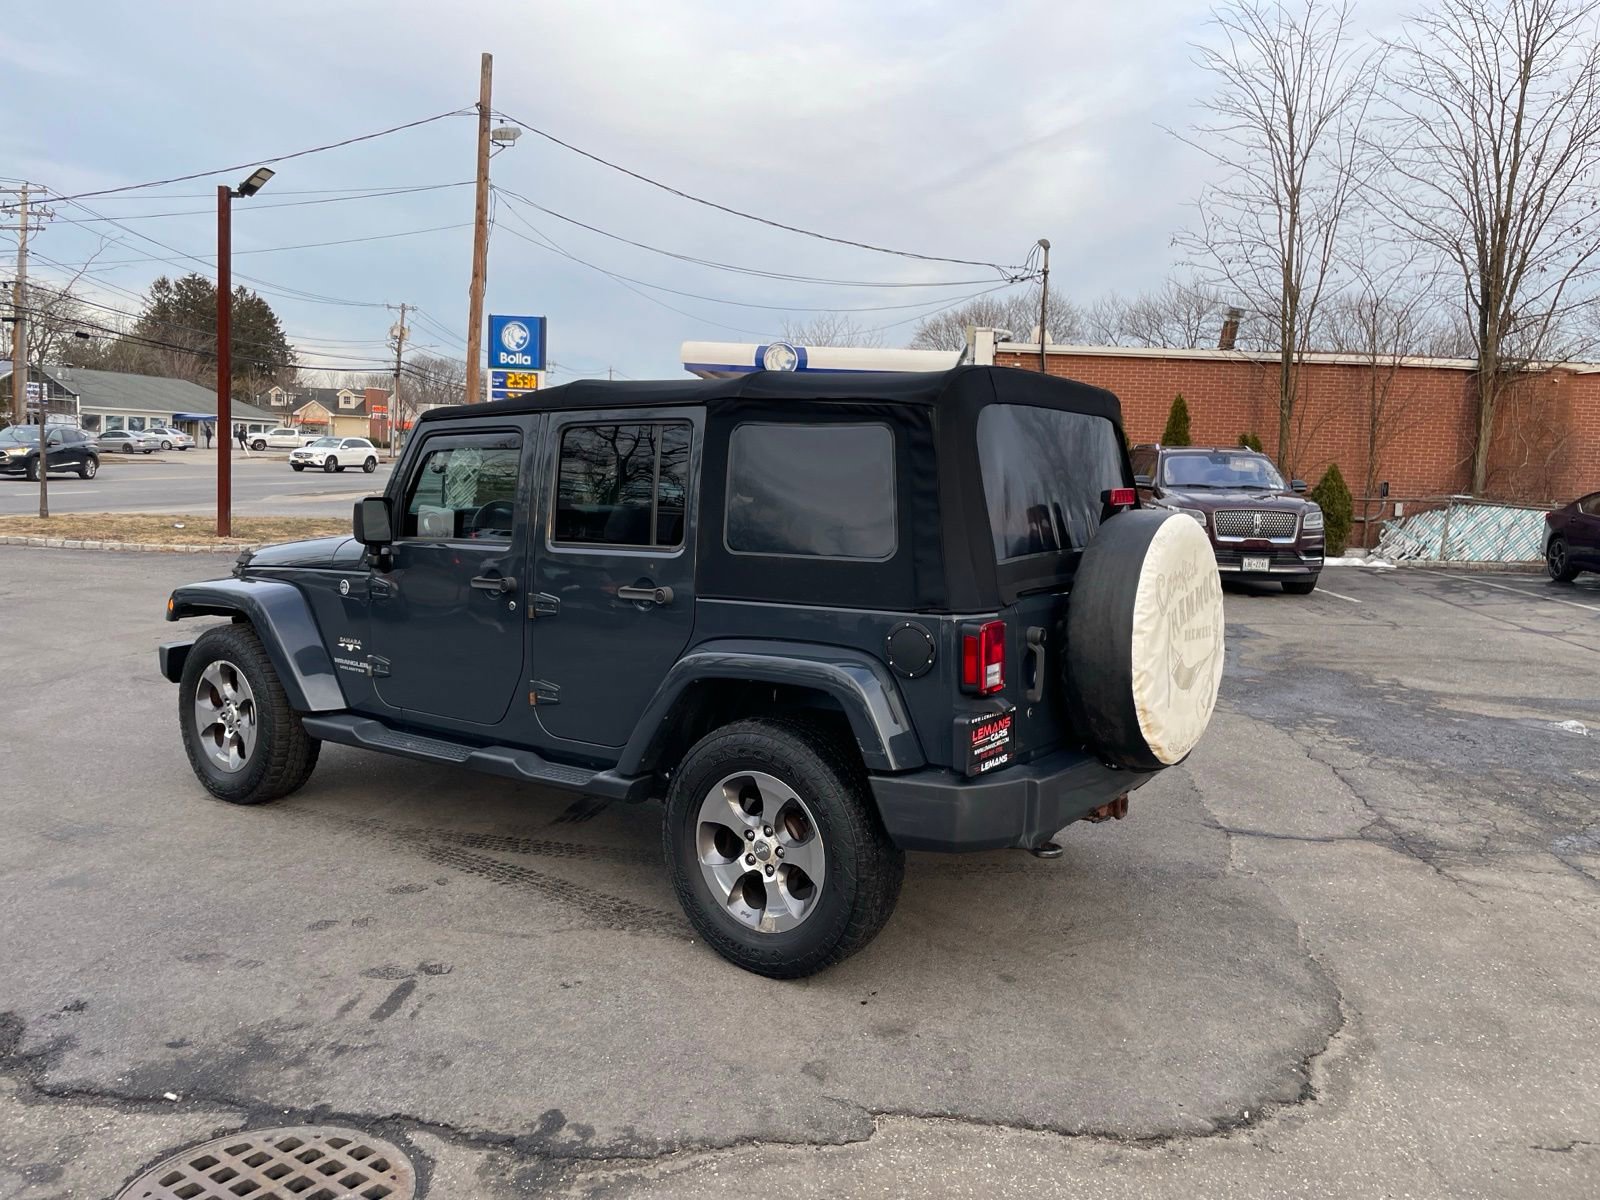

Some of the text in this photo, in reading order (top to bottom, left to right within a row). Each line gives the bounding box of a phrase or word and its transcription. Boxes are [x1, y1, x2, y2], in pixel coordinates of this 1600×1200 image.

[500, 352, 531, 365] Bolla
[334, 657, 369, 669] WRANGLER
[972, 716, 1012, 741] LEMANS
[990, 728, 1008, 741] CARS
[981, 753, 1008, 772] LEMANS
